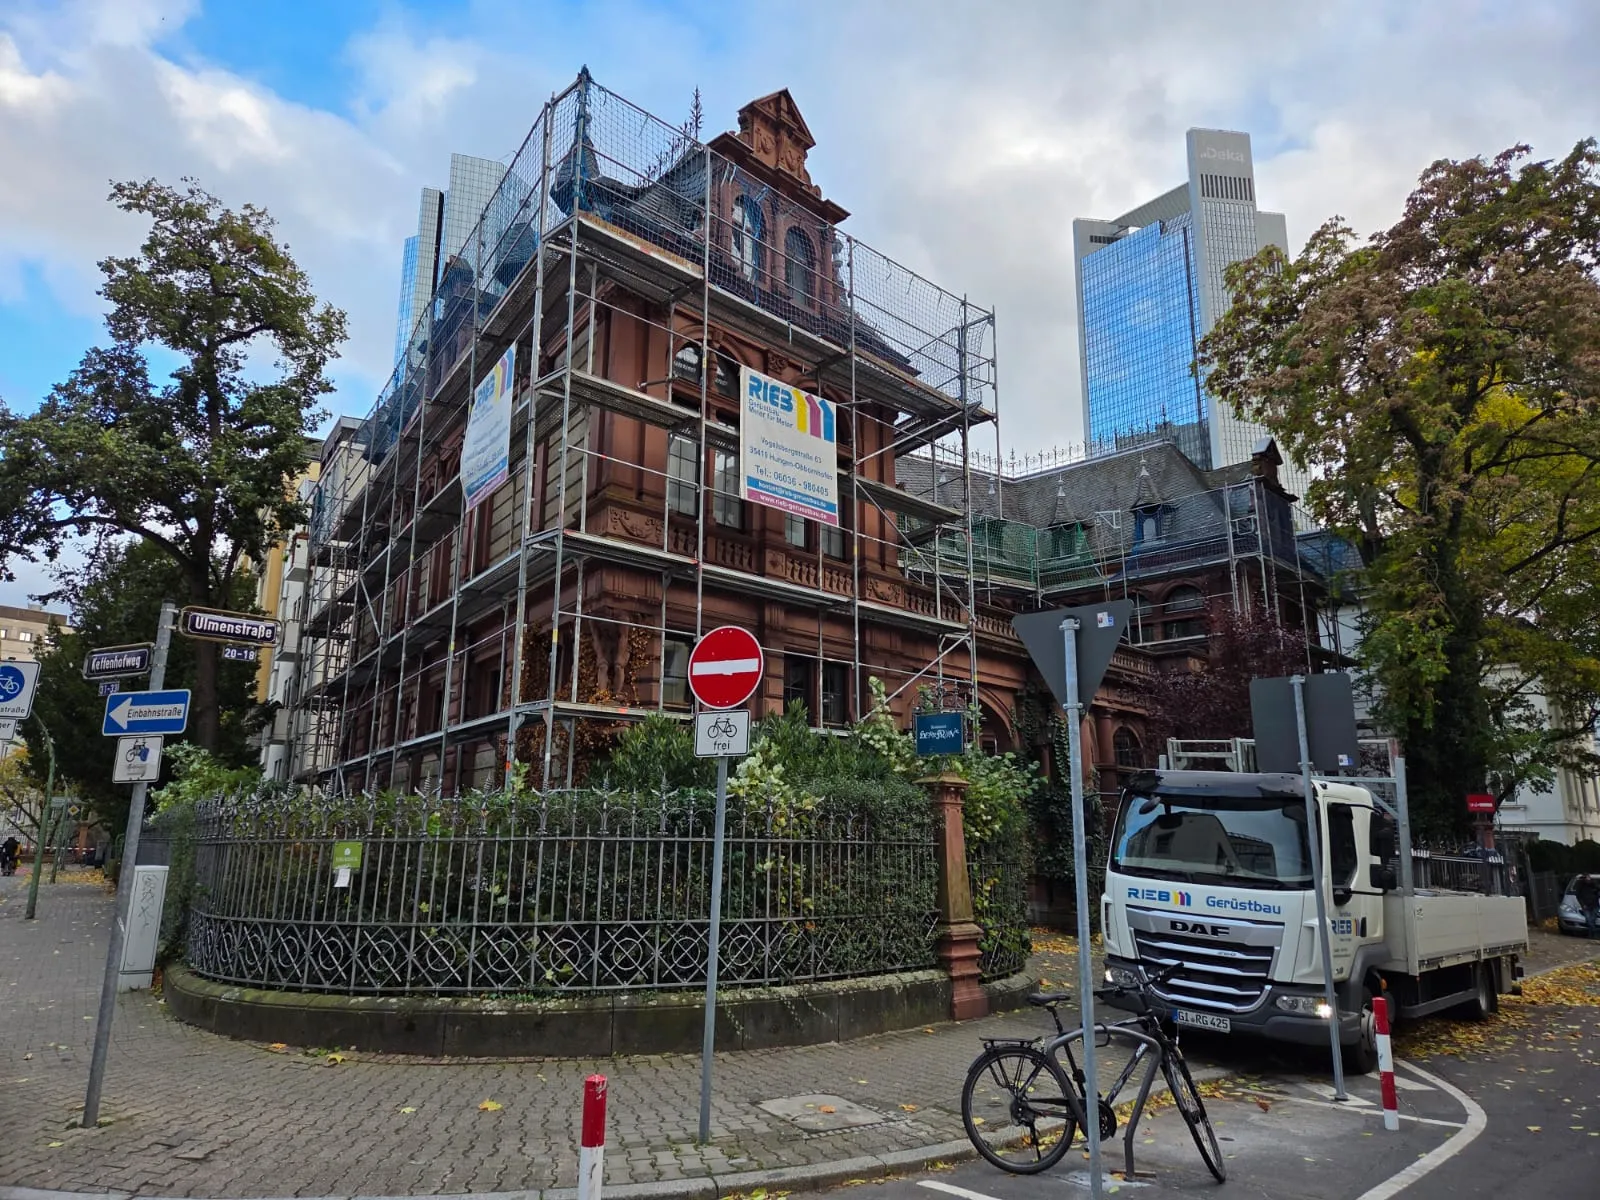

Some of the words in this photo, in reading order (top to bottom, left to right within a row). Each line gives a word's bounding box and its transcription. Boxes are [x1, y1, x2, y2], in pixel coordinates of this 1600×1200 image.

[1206, 146, 1244, 162] Deka
[749, 375, 794, 412] RIEB
[814, 456, 822, 464] 63
[755, 465, 772, 478] Tel.:
[773, 471, 797, 486] 06036
[803, 480, 829, 496] 980405
[195, 616, 273, 640] Ulmenstraße
[224, 648, 255, 660] 20-18
[91, 655, 141, 671] Kettenhofweg
[127, 706, 183, 719] Einbahnstraße
[713, 740, 731, 751] frei
[1128, 888, 1170, 902] RIEB
[1206, 895, 1281, 915] Gerüstbau
[1170, 920, 1230, 937] DAF
[1195, 1014, 1209, 1027] RG
[1210, 1016, 1229, 1029] 425
